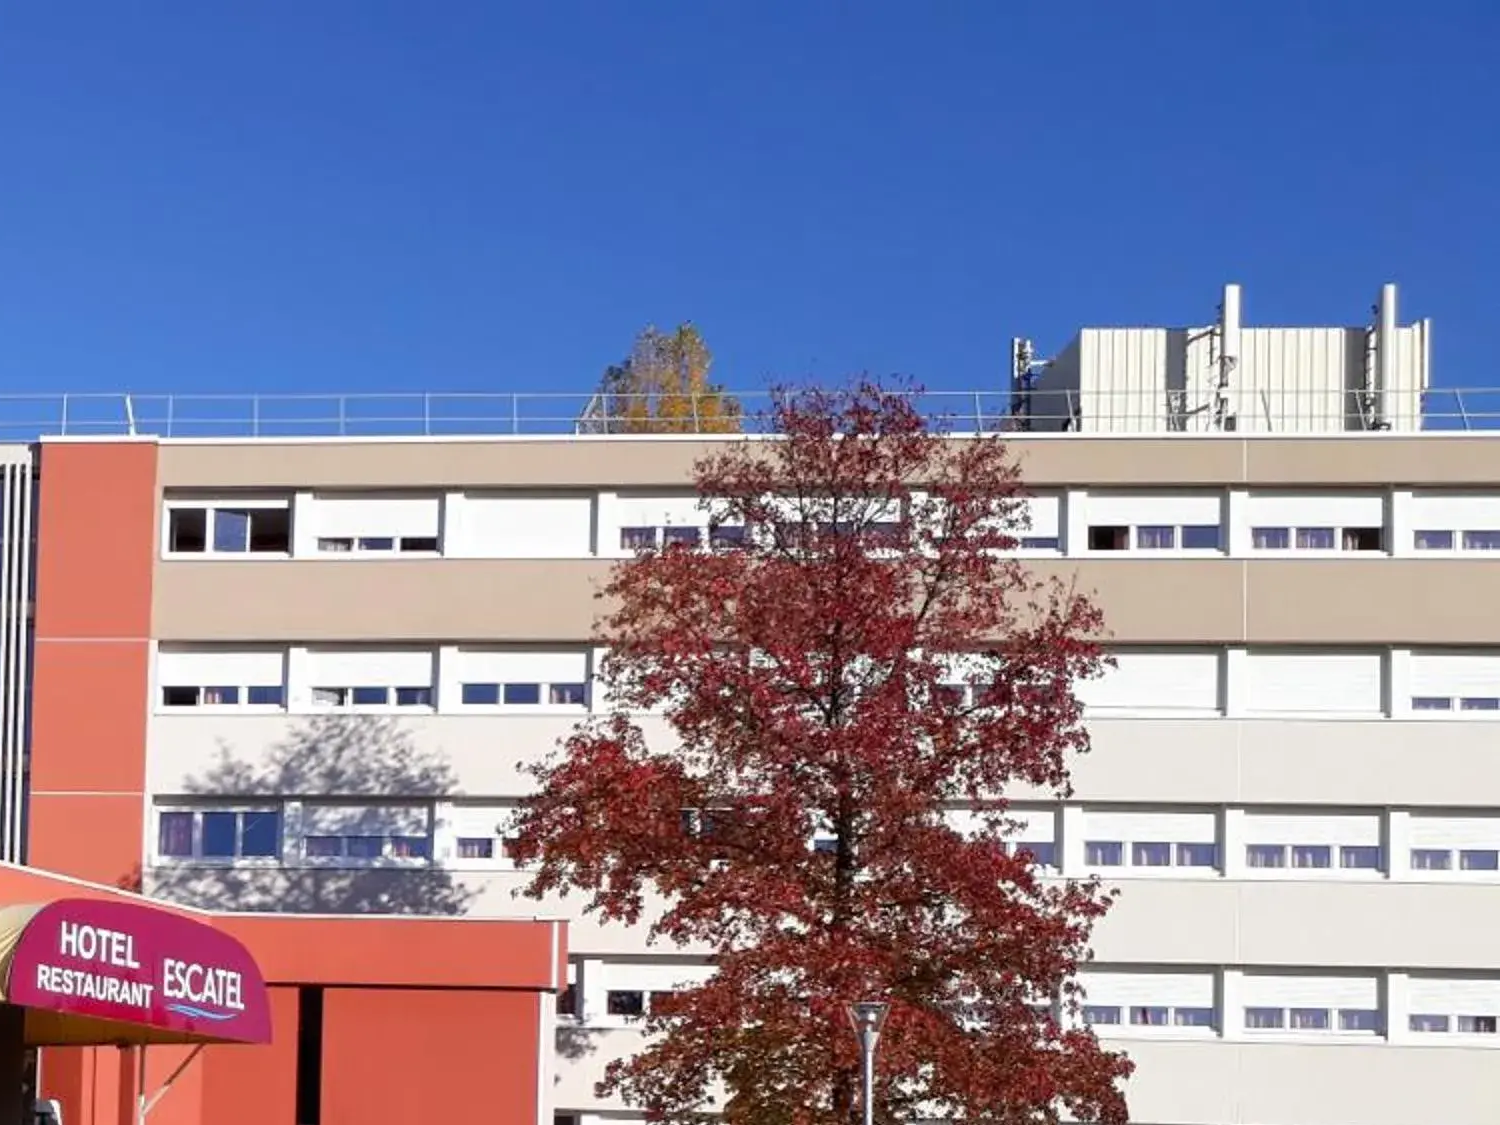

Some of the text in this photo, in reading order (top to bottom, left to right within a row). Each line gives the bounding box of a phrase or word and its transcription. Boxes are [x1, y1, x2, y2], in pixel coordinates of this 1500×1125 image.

[60, 920, 140, 969] HOTEL
[37, 964, 153, 1009] RESTAURANT
[163, 958, 245, 1010] ESCATEL
